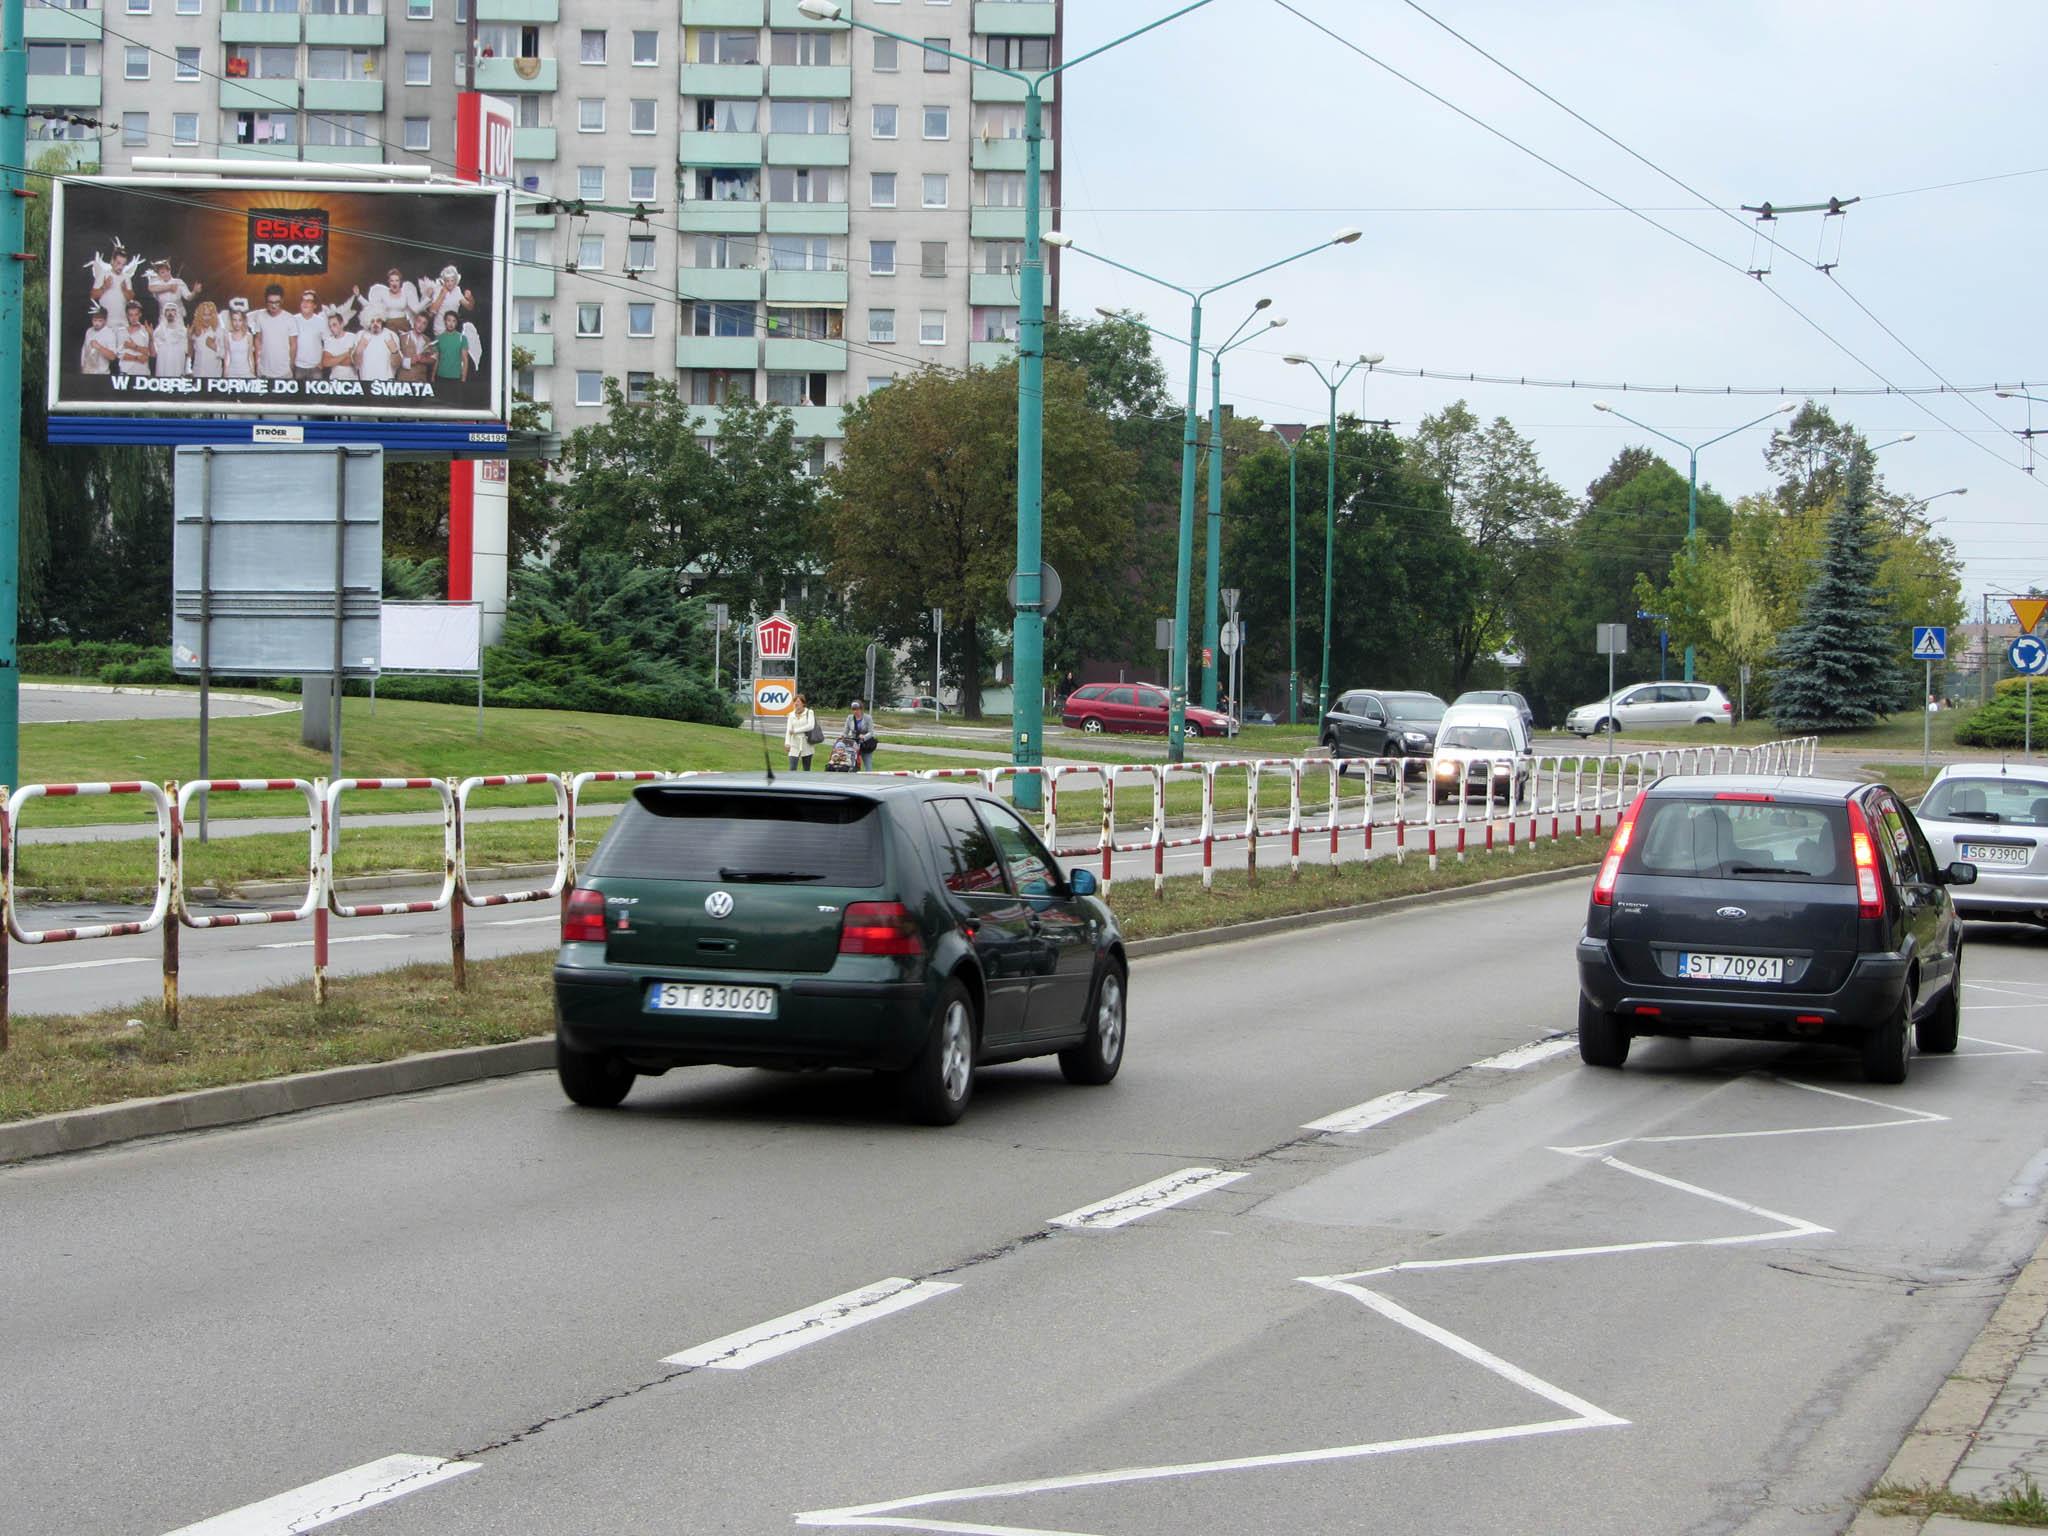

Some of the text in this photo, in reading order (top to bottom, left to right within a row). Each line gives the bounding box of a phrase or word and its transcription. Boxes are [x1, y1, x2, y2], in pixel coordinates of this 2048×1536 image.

[253, 243, 322, 266] ROCK
[111, 375, 434, 397] W DOBREJ FORMIE DO KOŃCA ŚWIATA
[759, 619, 793, 655] UTA
[760, 692, 789, 703] DKV
[1970, 847, 1986, 858] SG
[1690, 955, 1716, 974] ST
[1723, 957, 1778, 978] 70961
[665, 985, 769, 1011] ST 83060
